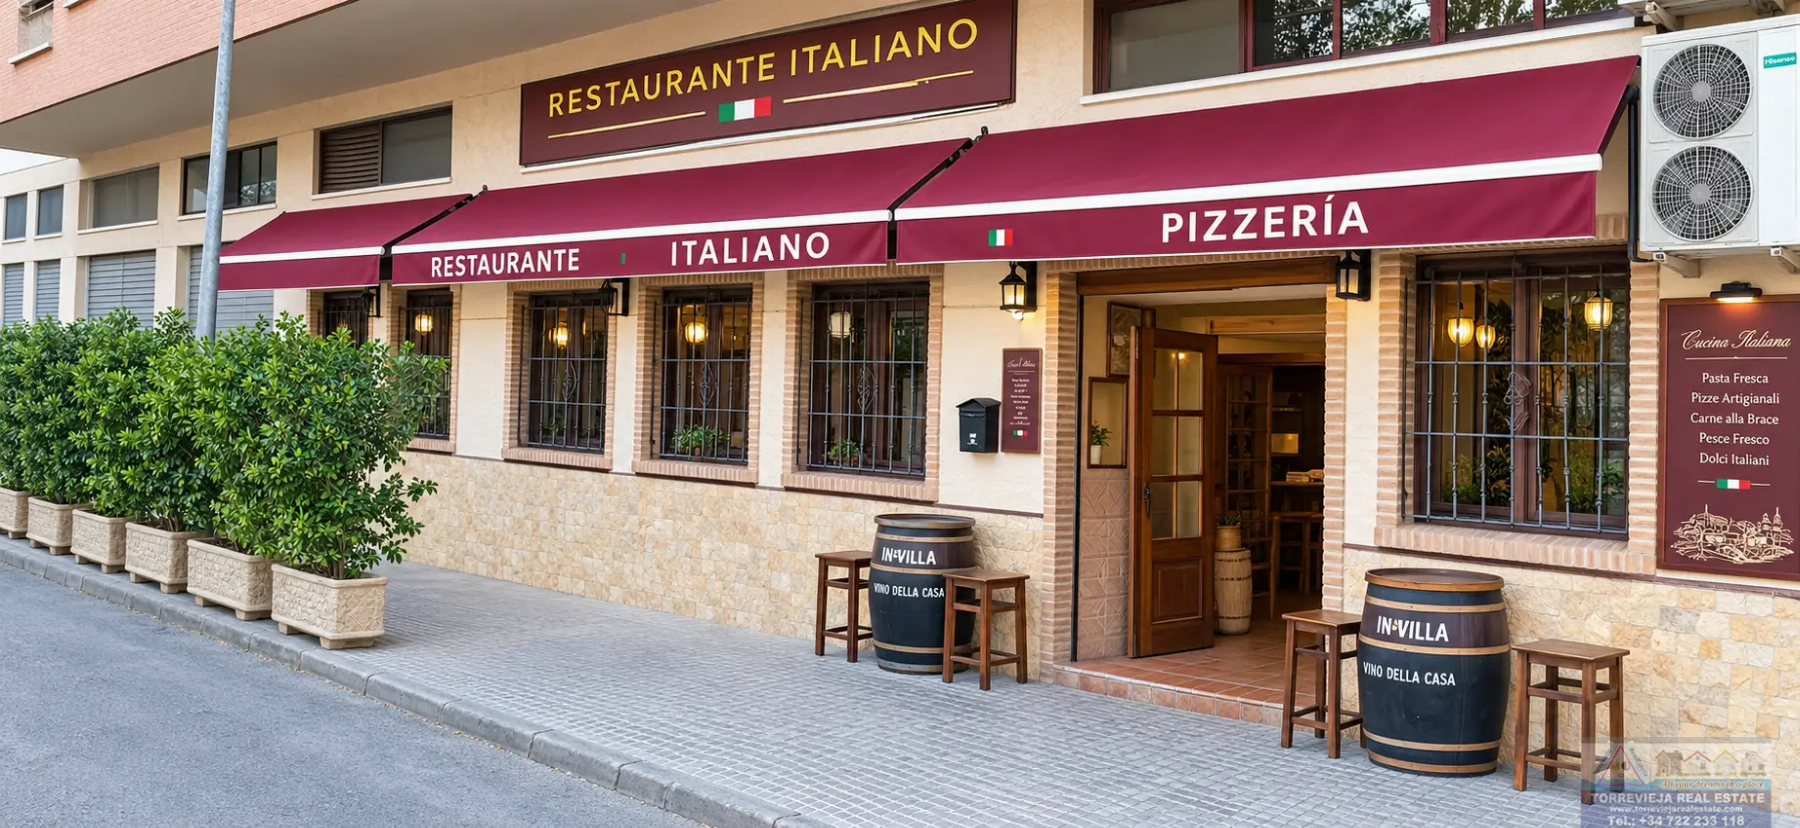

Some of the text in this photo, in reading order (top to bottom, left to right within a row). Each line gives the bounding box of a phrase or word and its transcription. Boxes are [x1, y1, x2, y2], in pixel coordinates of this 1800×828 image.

[548, 18, 979, 118] RESTAURANTE ITALIANO
[1162, 194, 1369, 243] PIZZERÍA
[431, 231, 830, 277] RESTAURANTE ITALIANO
[1681, 329, 1730, 350] Cucina
[1702, 372, 1769, 384] Pasta Fresca
[1691, 392, 1780, 407] Pizze Artigianali
[1690, 412, 1779, 425] Carne alla Brace
[1699, 432, 1770, 445] Pesce Fresco
[1699, 452, 1770, 466] Dolci Italiani
[874, 582, 945, 598] VINO DELLA CASA
[1363, 661, 1456, 686] VINO DELLA CASA
